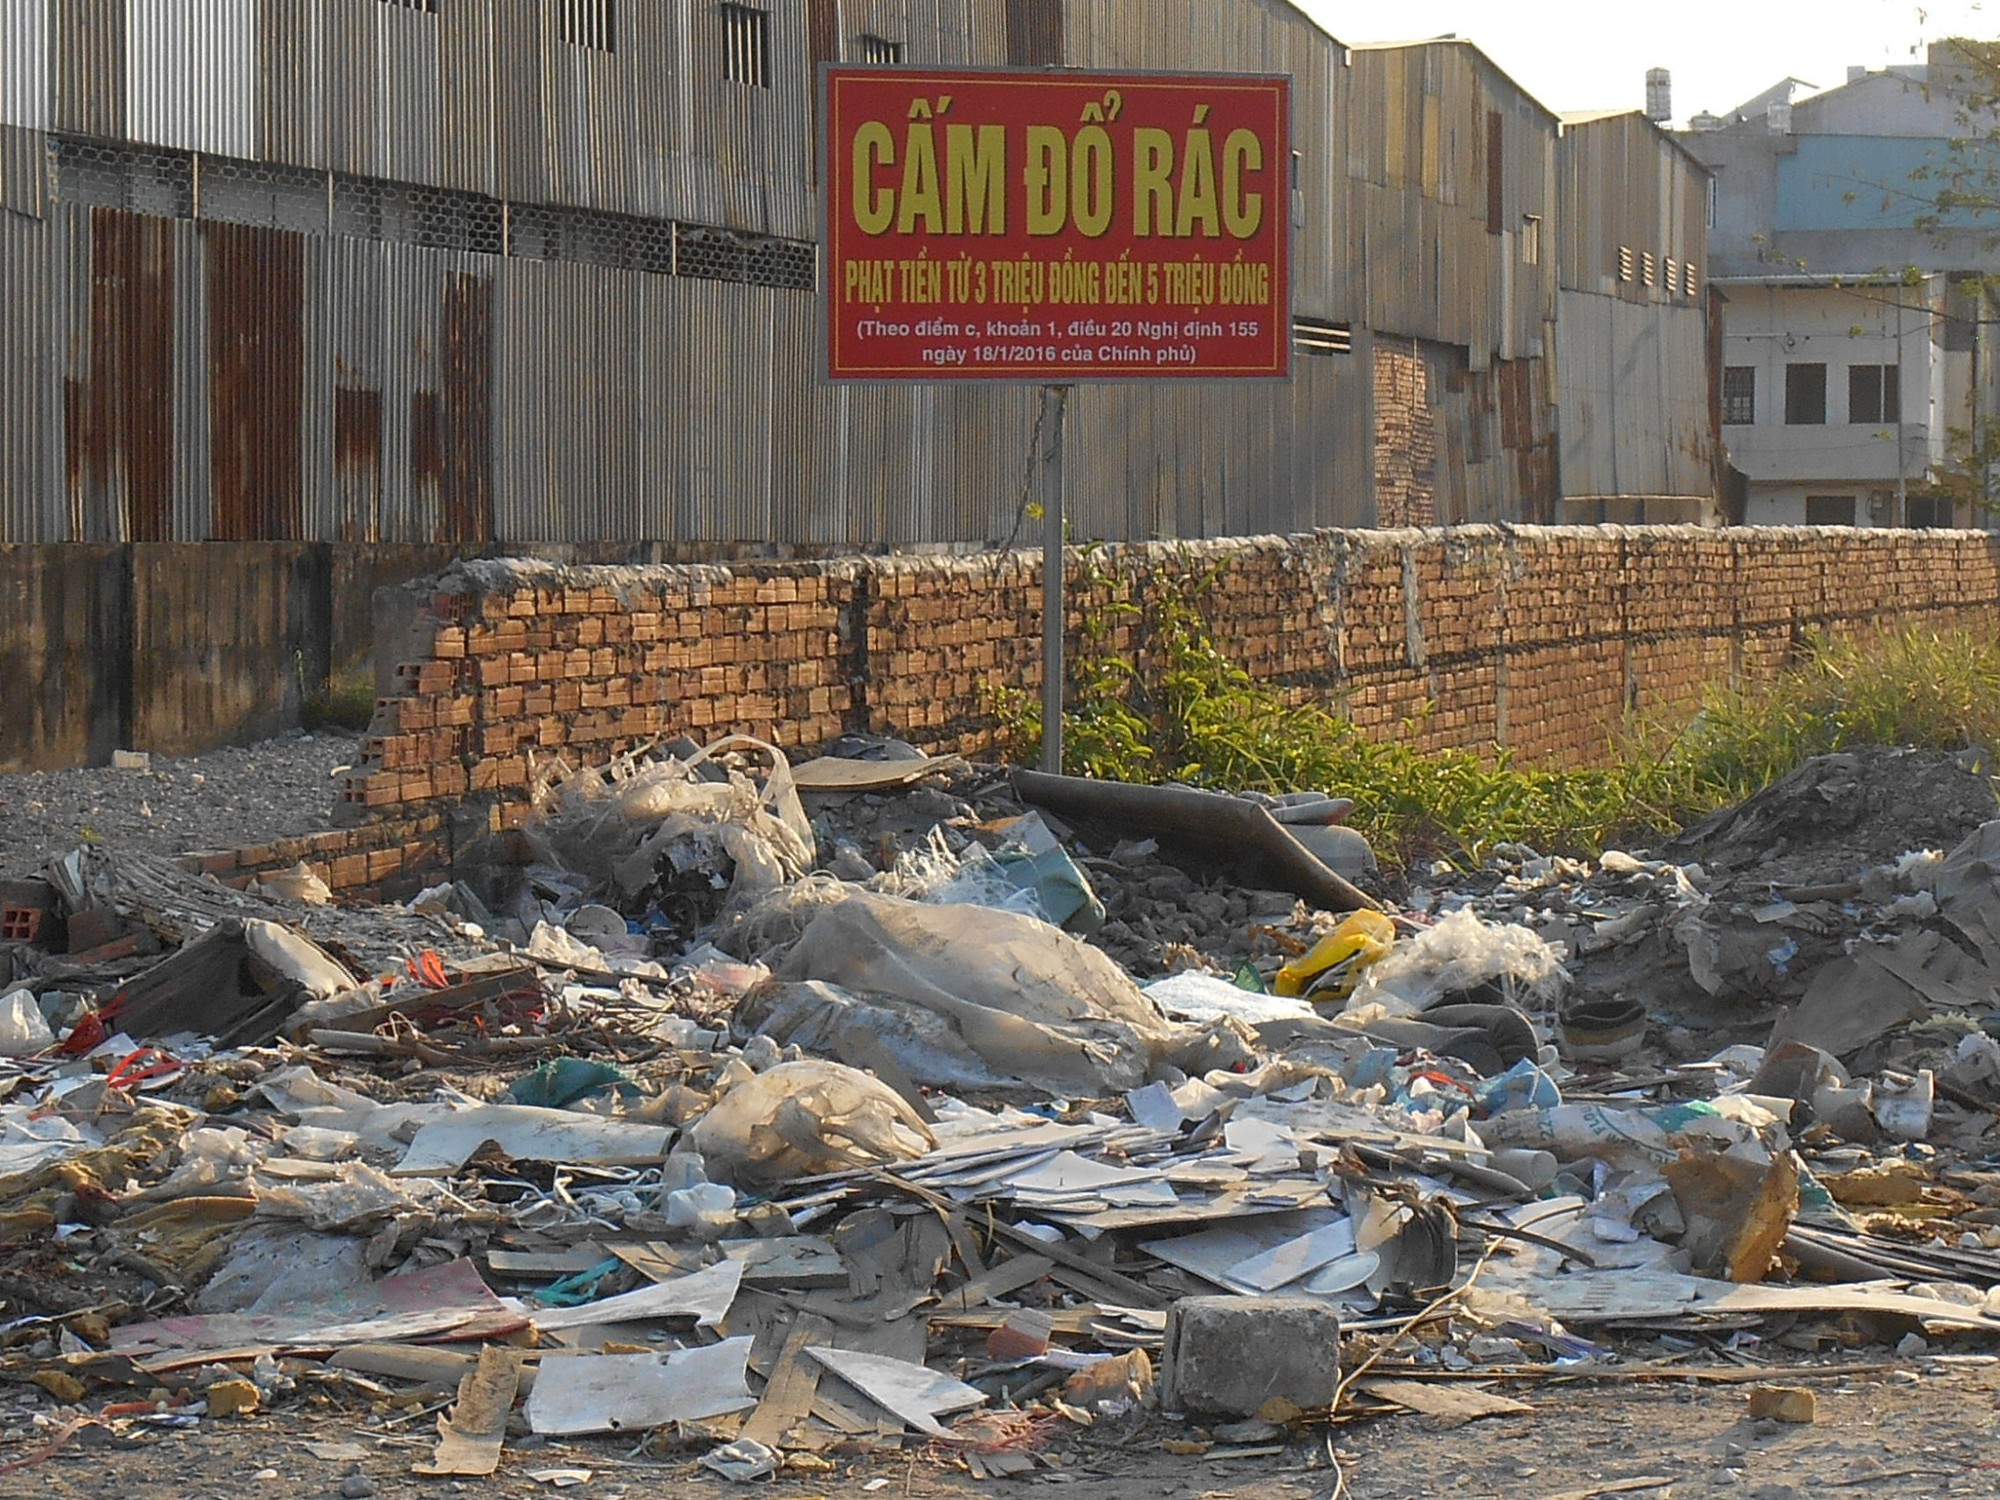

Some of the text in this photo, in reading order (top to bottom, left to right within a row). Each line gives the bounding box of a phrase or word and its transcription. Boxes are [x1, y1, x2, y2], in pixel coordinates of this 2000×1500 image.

[852, 89, 1262, 239] CẤM ĐỔ RÁC
[845, 246, 1269, 314] PHẠT TIỀN TỪ 3 TRIỆU ĐỒNG ĐẾN 5 TRIỆU ĐỒNG
[857, 320, 910, 340] (Theo
[914, 316, 959, 337] điểm
[986, 318, 1041, 337] khoản
[1067, 318, 1106, 337] điều
[1111, 321, 1132, 337] 20
[1137, 321, 1178, 341] Nghị
[1183, 321, 1223, 340] định
[1228, 321, 1259, 337] 155
[922, 343, 1196, 365] ngày 18/1/2016 của Chính phủ)
